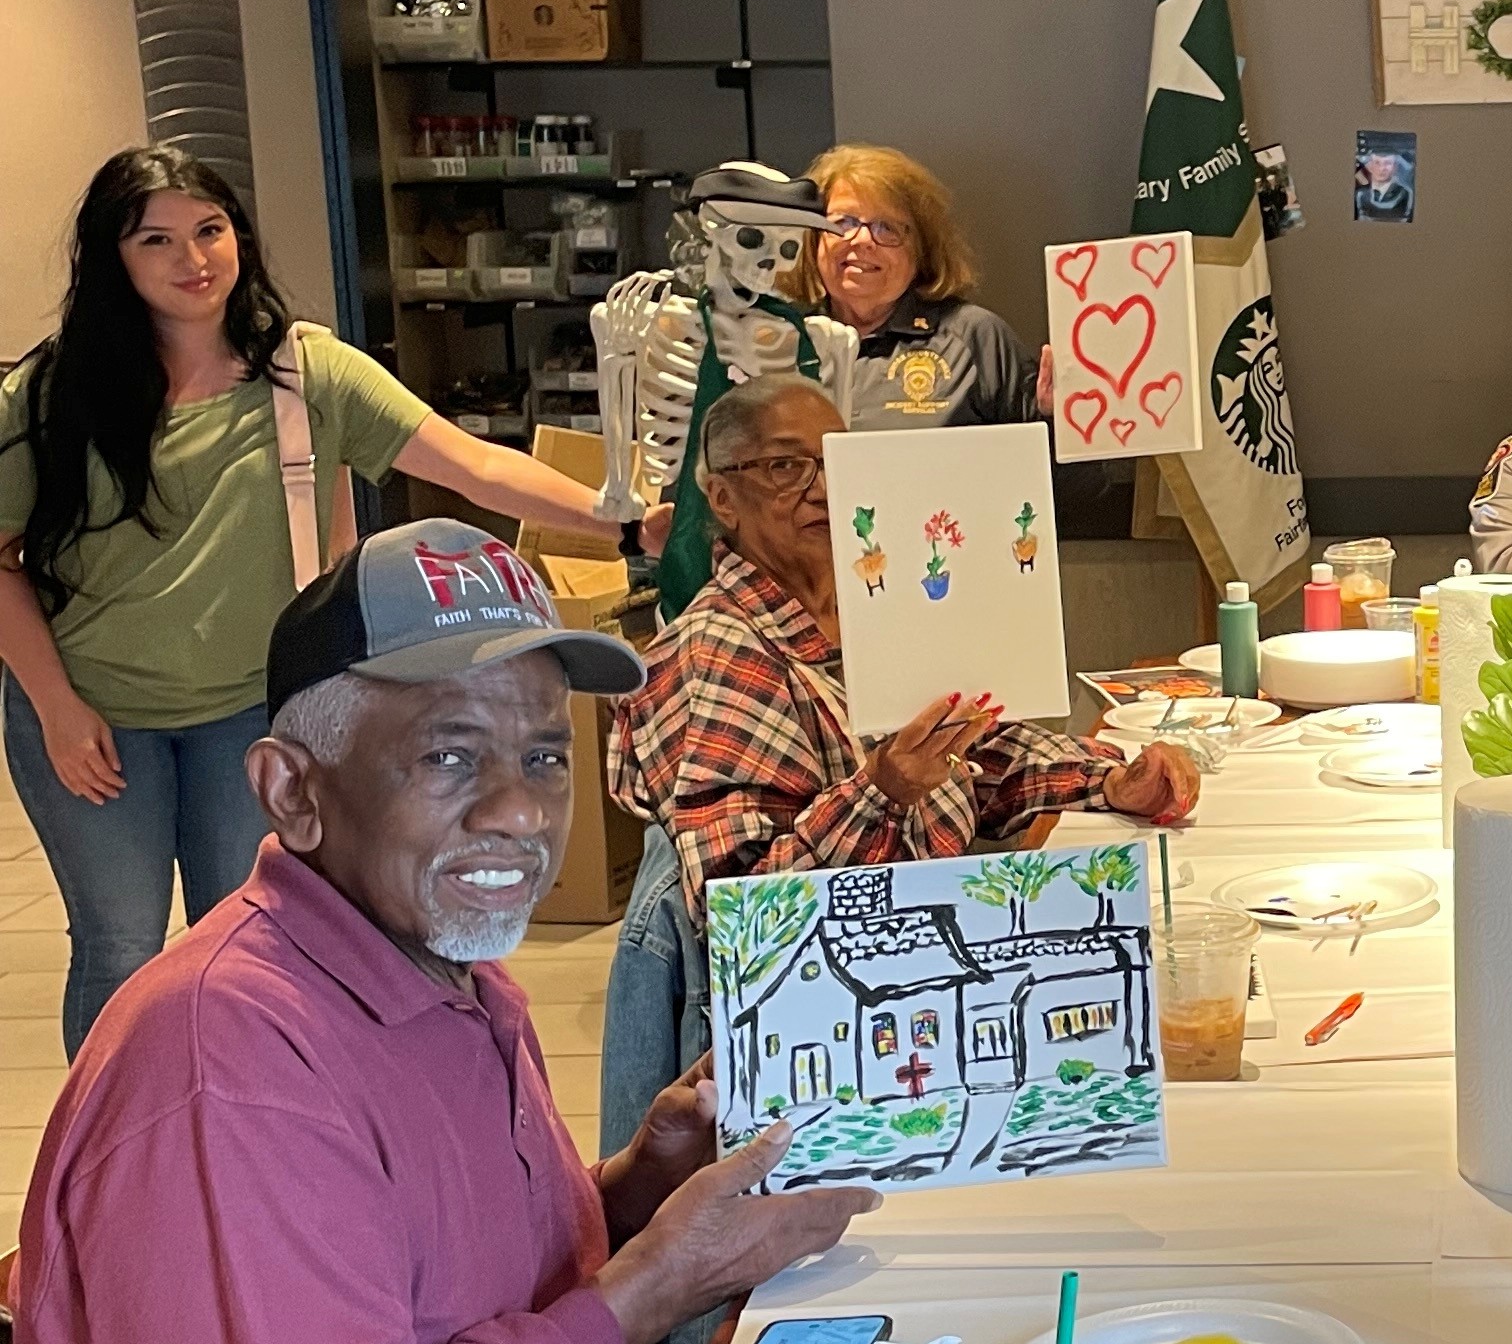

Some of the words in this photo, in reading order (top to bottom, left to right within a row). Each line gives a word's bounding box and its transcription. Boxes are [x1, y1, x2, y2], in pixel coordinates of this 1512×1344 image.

[1177, 142, 1242, 191] Family
[413, 542, 554, 620] FAITH
[434, 608, 472, 628] FAITH
[479, 606, 522, 622] THAT'S
